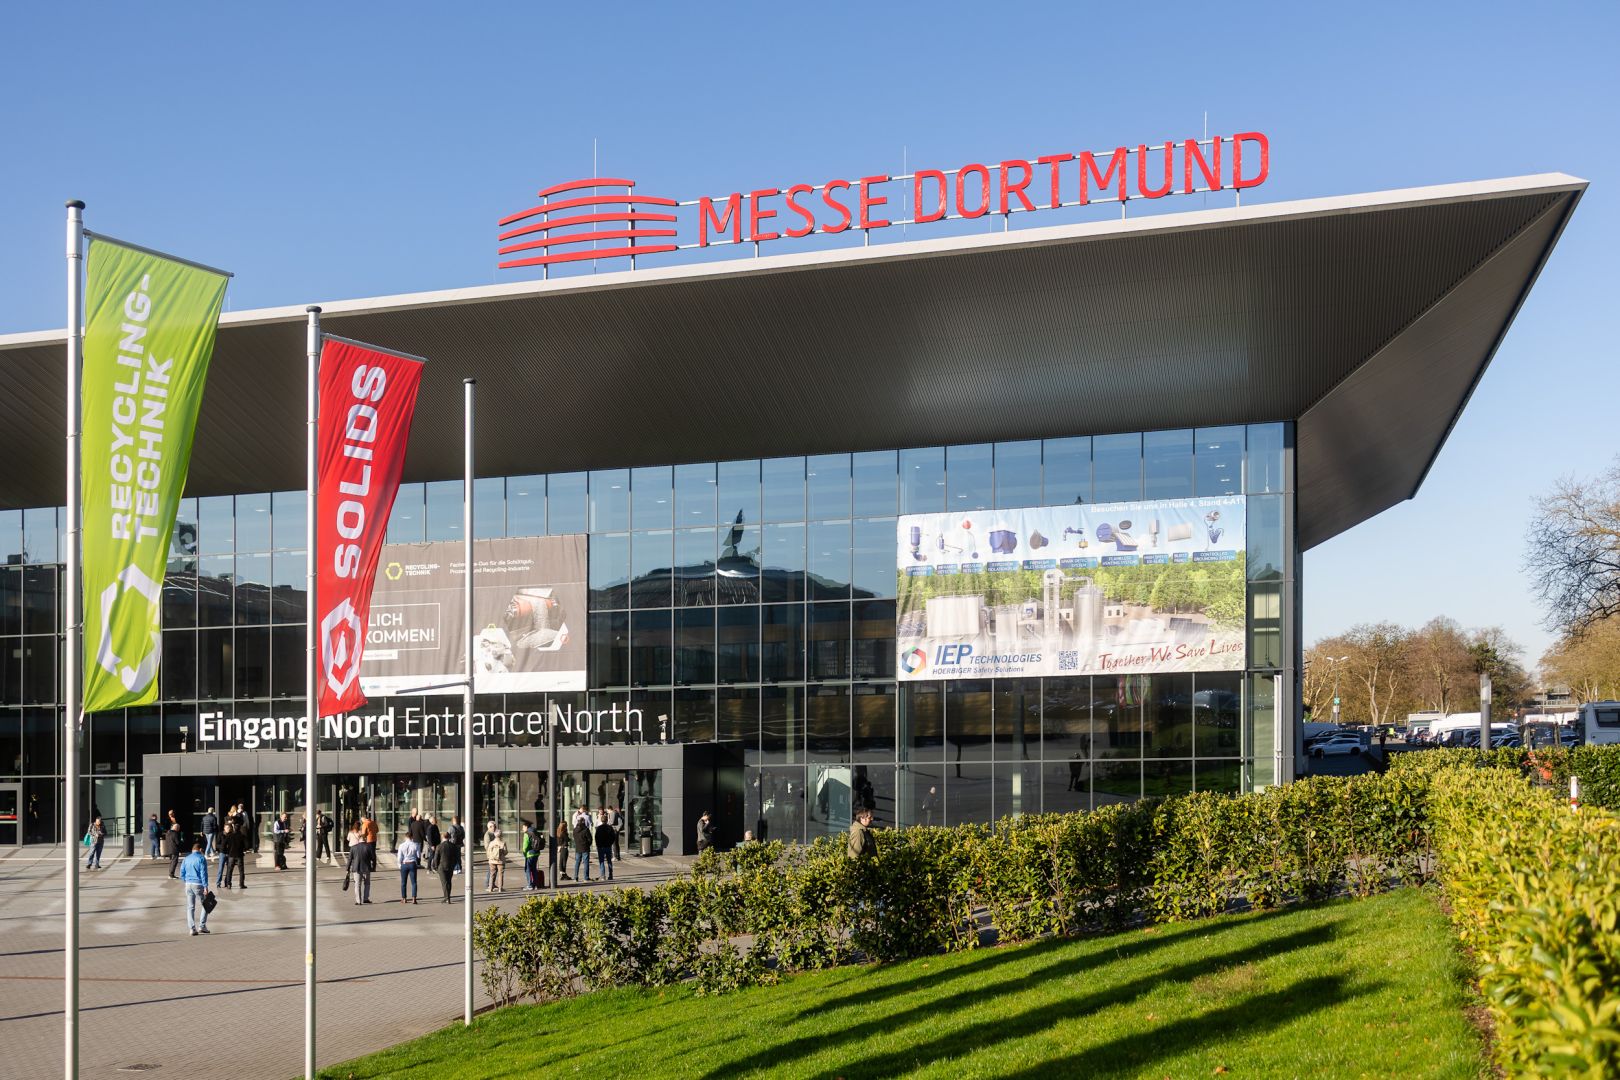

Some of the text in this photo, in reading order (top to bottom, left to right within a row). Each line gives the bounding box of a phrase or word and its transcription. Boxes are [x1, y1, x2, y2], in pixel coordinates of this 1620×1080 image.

[699, 132, 1270, 248] MESSE DORTMUND
[111, 273, 151, 541] RECYCLING-
[136, 352, 174, 543] TECHNIK
[334, 364, 387, 579] SOLIDS
[1091, 504, 1128, 513] Besuchen
[1199, 498, 1221, 507] Stand
[368, 612, 402, 626] LICH
[366, 628, 434, 644] KOMMEN!
[934, 644, 973, 666] IEP
[970, 654, 1042, 664] TECHNOLOGIES
[1098, 639, 1243, 672] Together We Save Lives
[199, 700, 643, 749] Eingang Nord Entrance North
